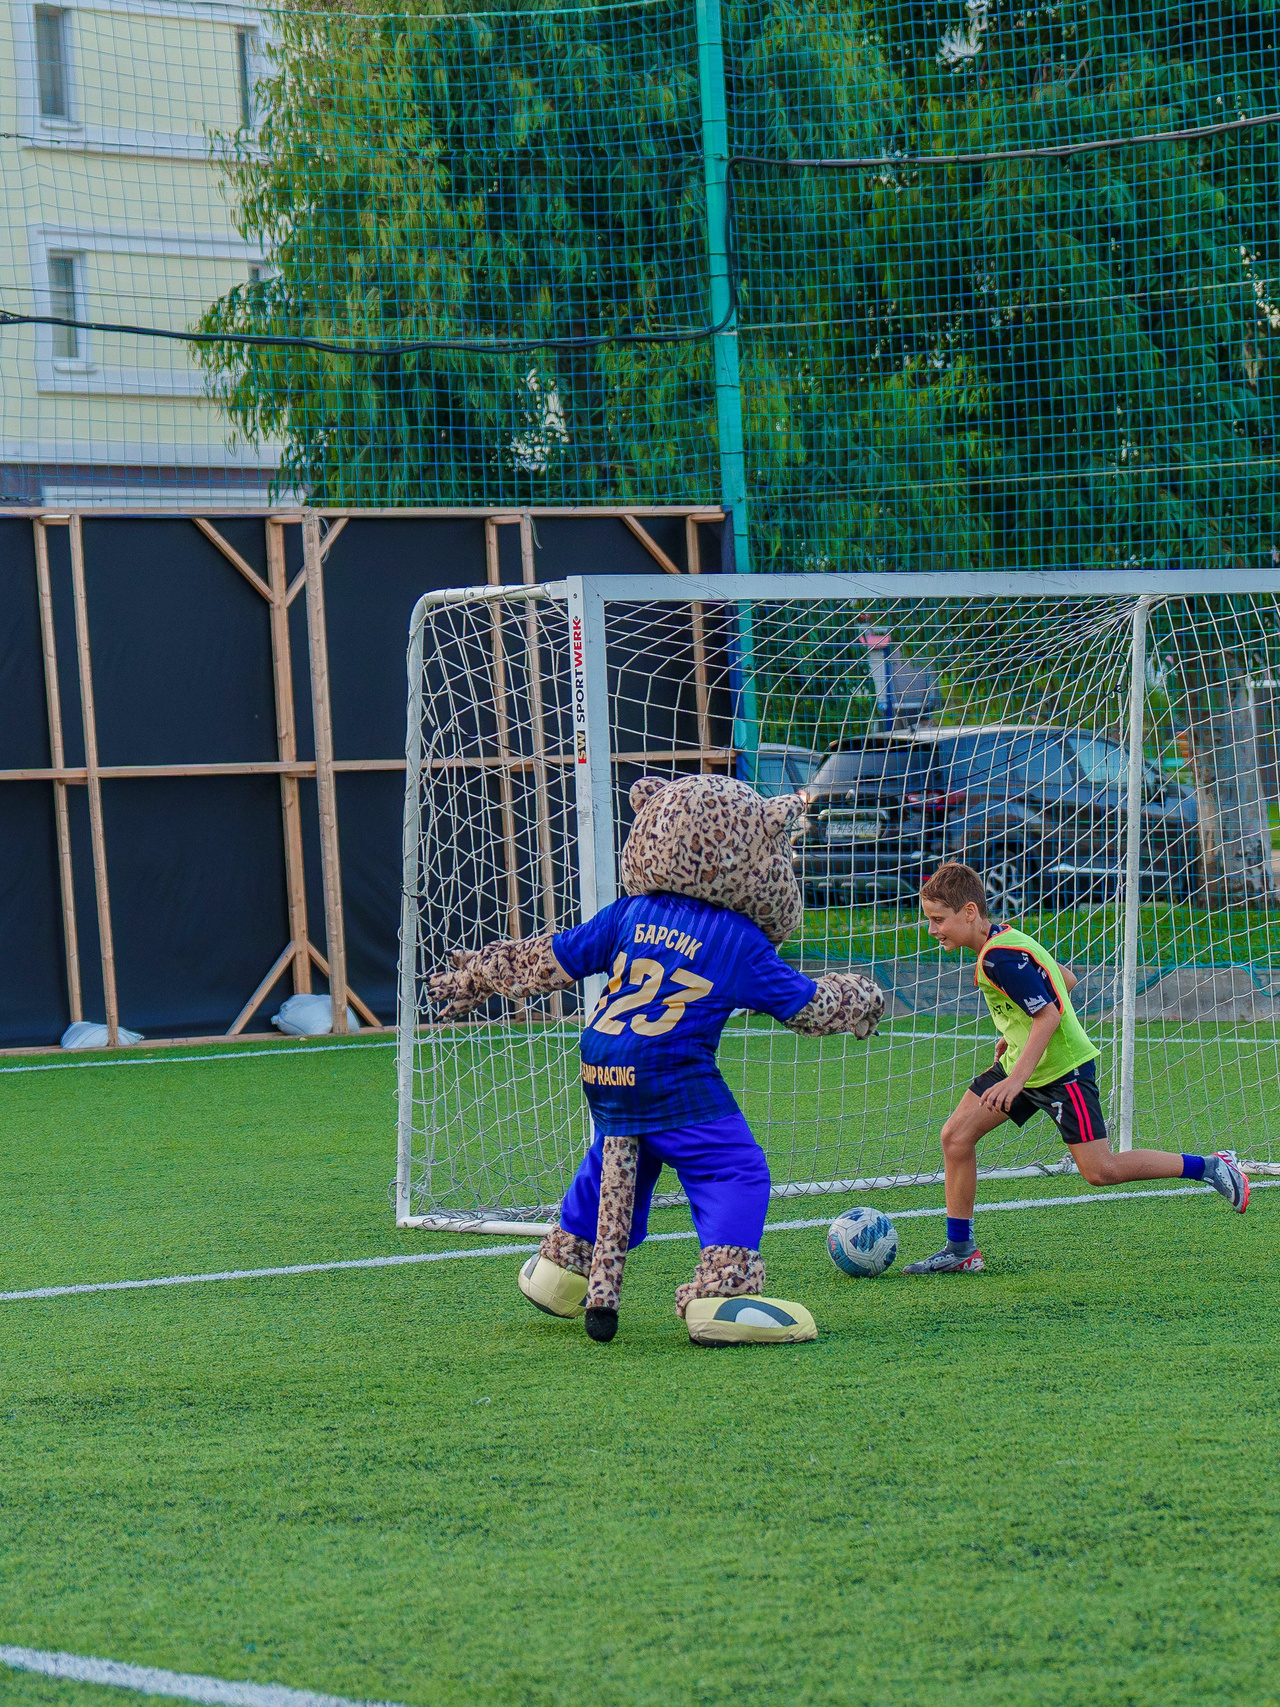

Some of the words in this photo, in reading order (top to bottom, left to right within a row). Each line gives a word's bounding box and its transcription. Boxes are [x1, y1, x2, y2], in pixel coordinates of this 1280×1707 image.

[572, 618, 586, 723] SPORTWERK
[634, 923, 703, 960] БАРСИК
[587, 951, 714, 1036] 123
[597, 1065, 636, 1087] RACING
[1051, 1101, 1063, 1124] 7
